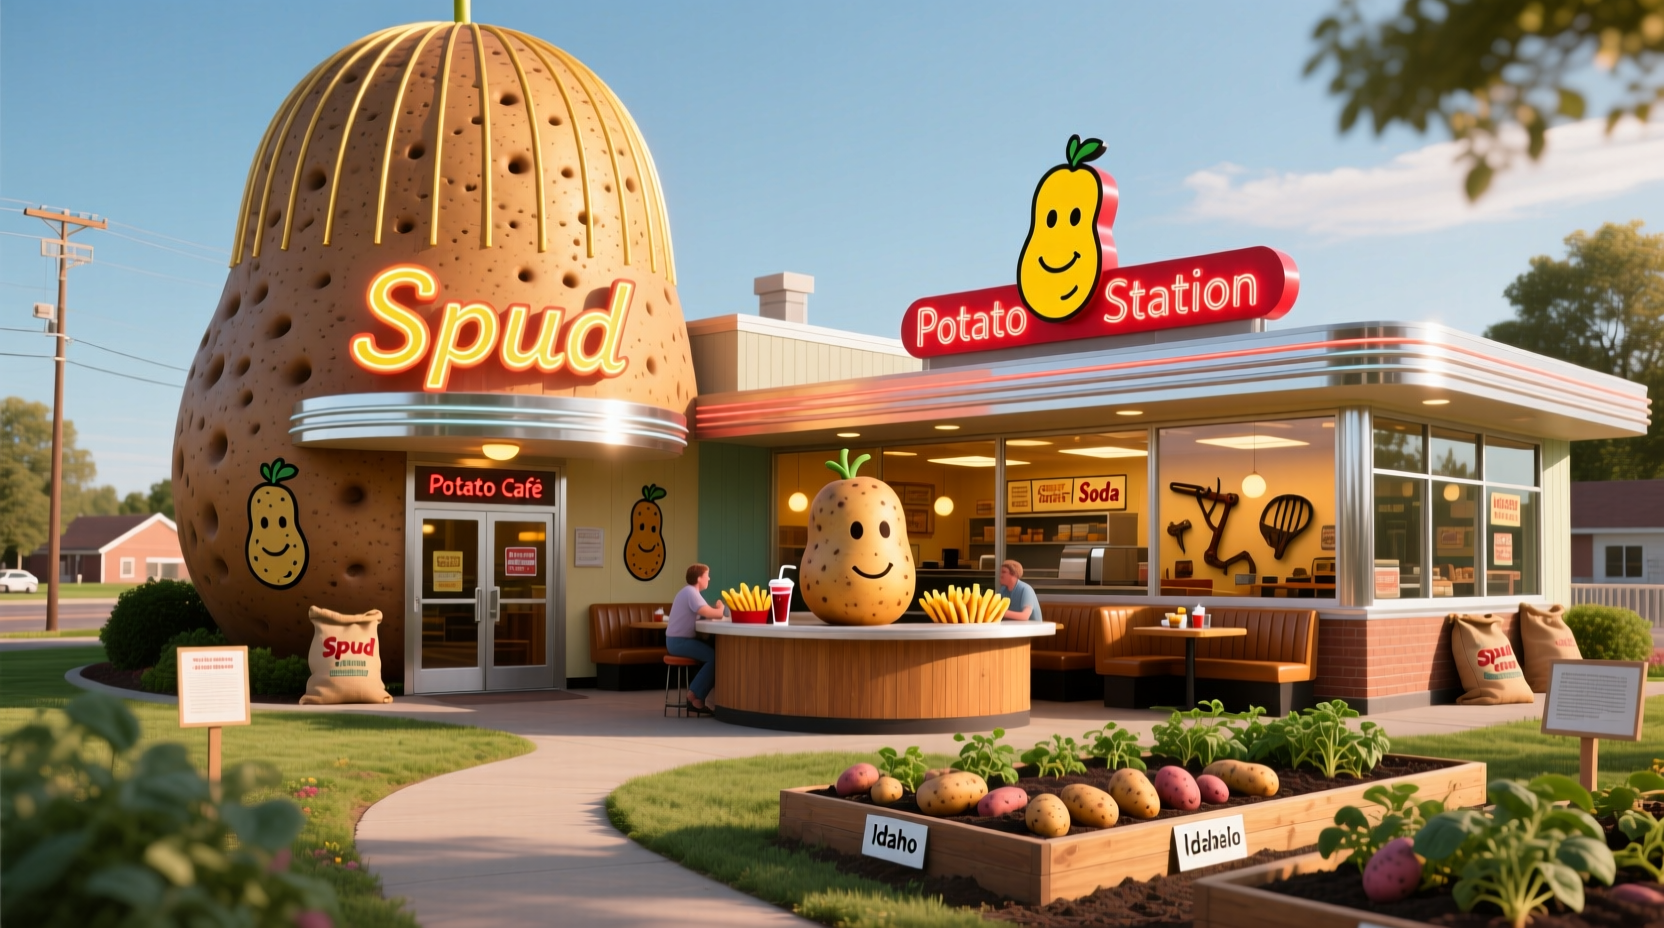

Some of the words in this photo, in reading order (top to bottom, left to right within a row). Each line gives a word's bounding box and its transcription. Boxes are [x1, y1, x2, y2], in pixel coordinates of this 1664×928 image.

[915, 301, 1027, 348] Potato
[1103, 268, 1258, 323] Station
[350, 264, 635, 391] Spud
[429, 473, 496, 497] Potato
[1078, 480, 1120, 503] Soda
[322, 636, 376, 660] Spud
[871, 823, 918, 854] Idaho
